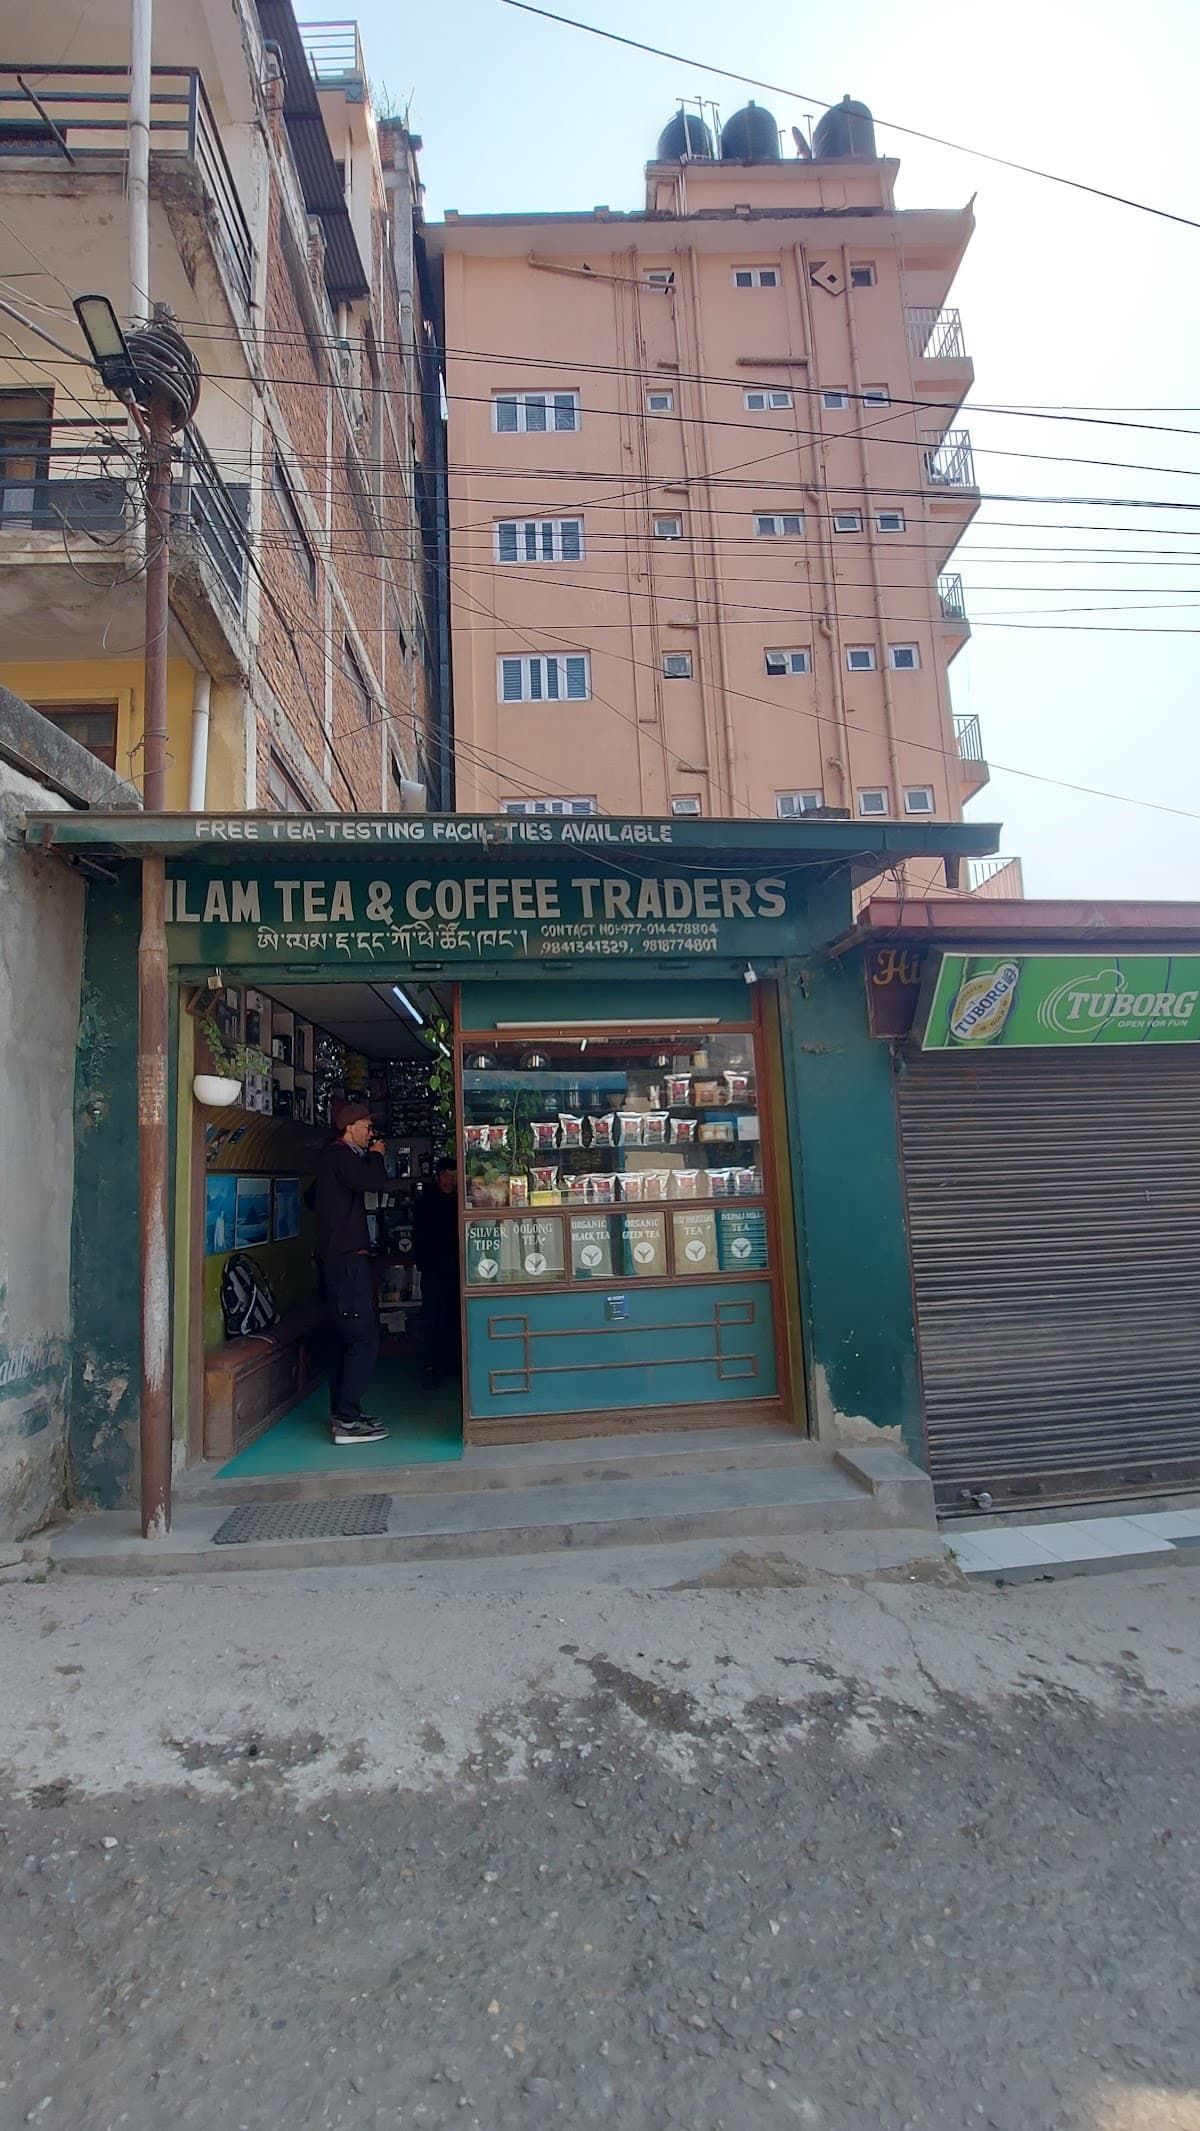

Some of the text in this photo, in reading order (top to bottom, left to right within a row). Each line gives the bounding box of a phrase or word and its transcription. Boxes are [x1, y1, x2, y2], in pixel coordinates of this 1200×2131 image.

[195, 820, 673, 843] FREE TEA-TESTING FACILTIES AVAILABLE
[164, 878, 787, 927] ILAM TEA & COFFEE TRADERS
[540, 923, 596, 939] CONTACT
[643, 938, 718, 953] 9818774801
[955, 981, 1009, 1033] TUBORG
[1066, 990, 1199, 1020] TUBORG
[1117, 1020, 1144, 1028] OPEN
[513, 1223, 553, 1235] OOLONG
[571, 1219, 607, 1230] ORGANIC
[625, 1219, 659, 1228] ORGANIC
[730, 1223, 750, 1232] TEA
[469, 1226, 509, 1239] SILVER
[596, 1230, 611, 1240] TEA
[645, 1230, 660, 1239] TEA
[683, 1226, 703, 1236] TEA
[474, 1239, 500, 1251] TIPS
[522, 1234, 544, 1246] TEA
